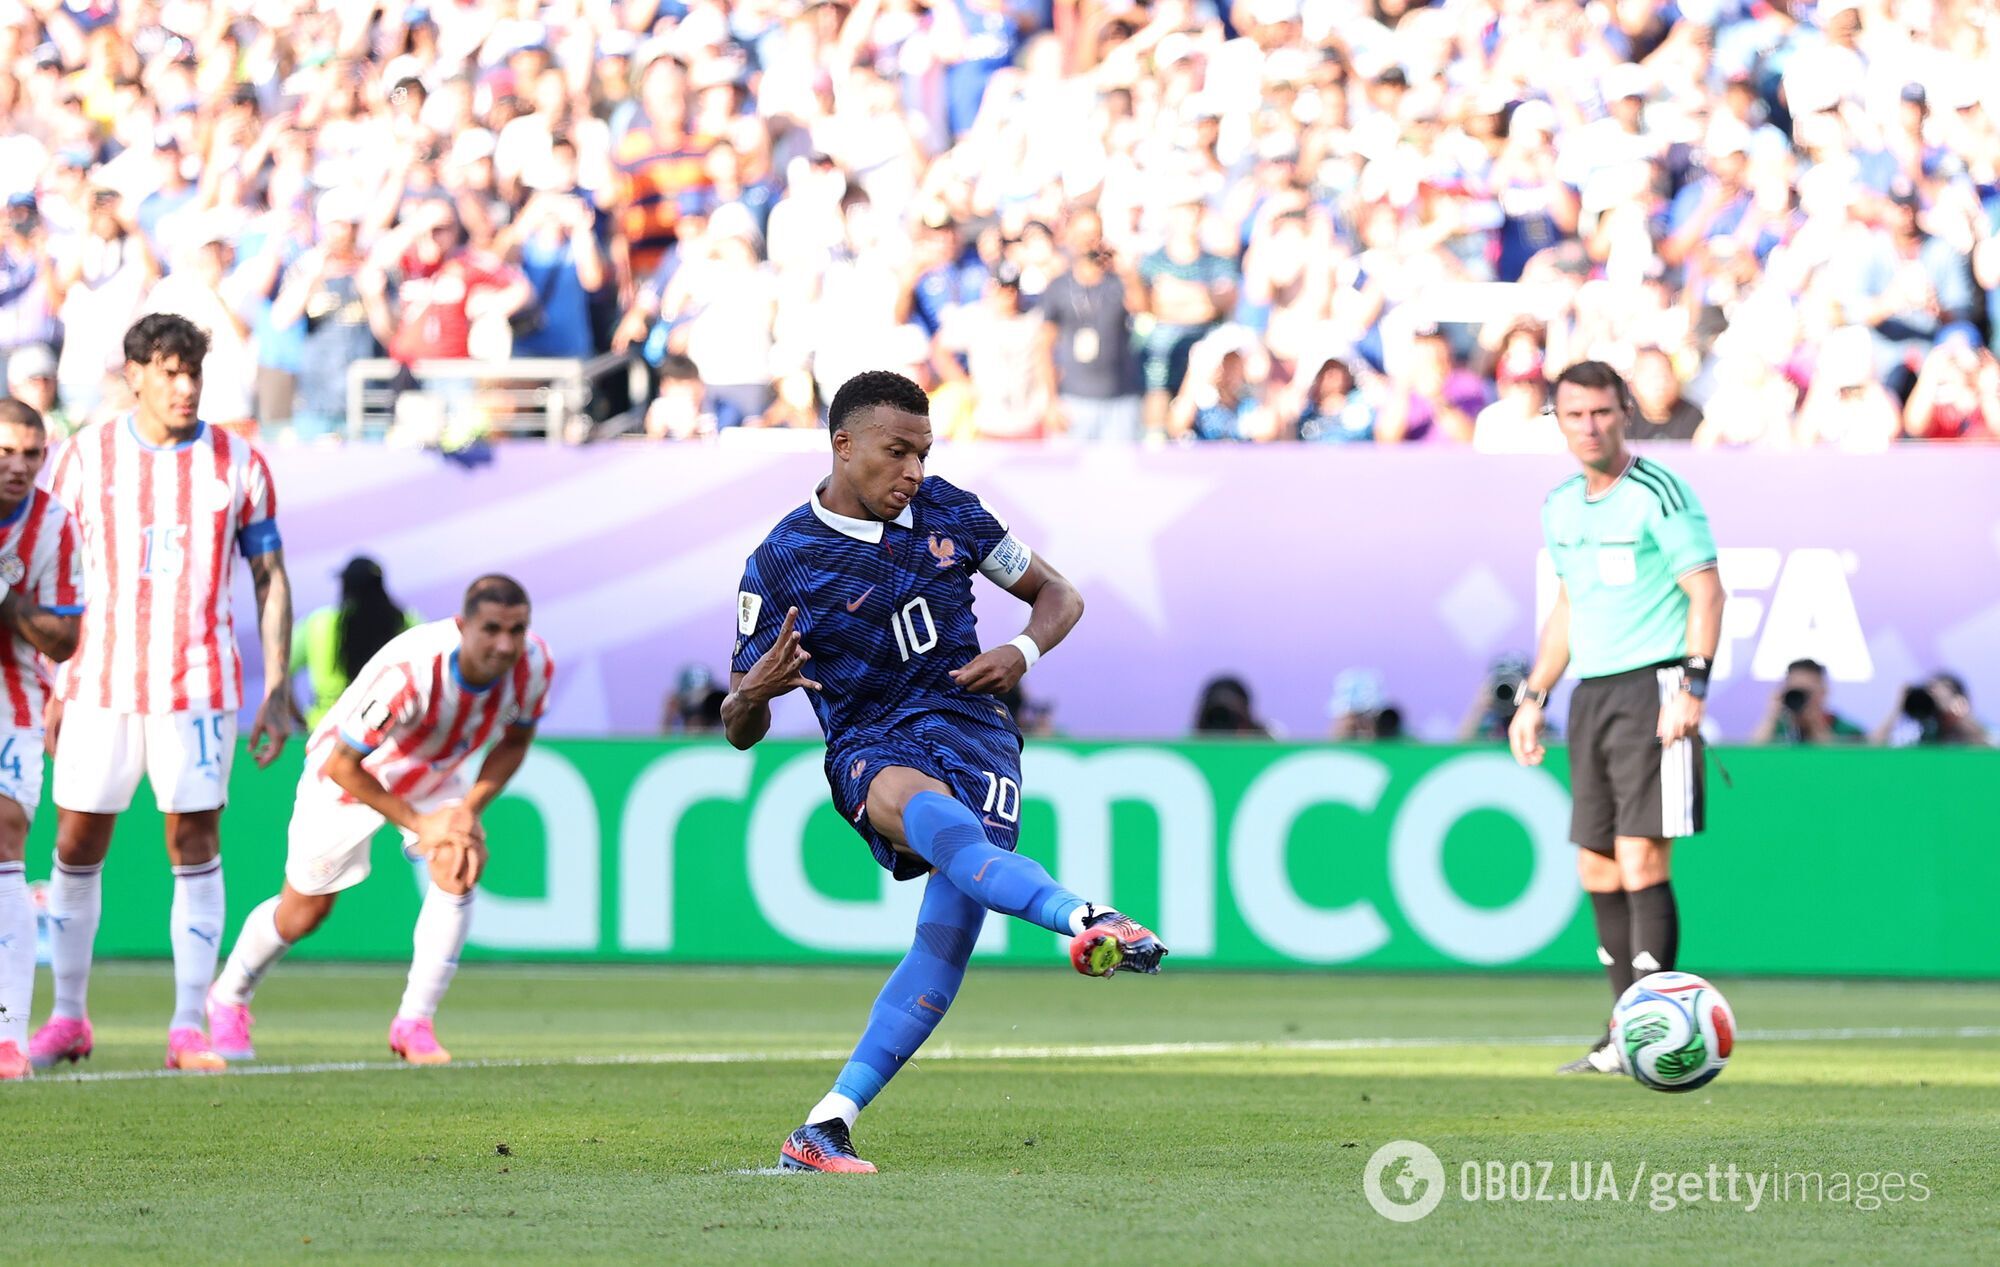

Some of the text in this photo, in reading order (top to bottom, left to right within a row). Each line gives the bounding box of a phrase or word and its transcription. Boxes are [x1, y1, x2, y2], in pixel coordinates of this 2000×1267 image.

[993, 533, 1011, 561] FOOTBA
[891, 596, 938, 663] 10
[1535, 547, 1876, 682] FA
[982, 770, 1020, 823] 10
[410, 742, 1584, 967] aramco
